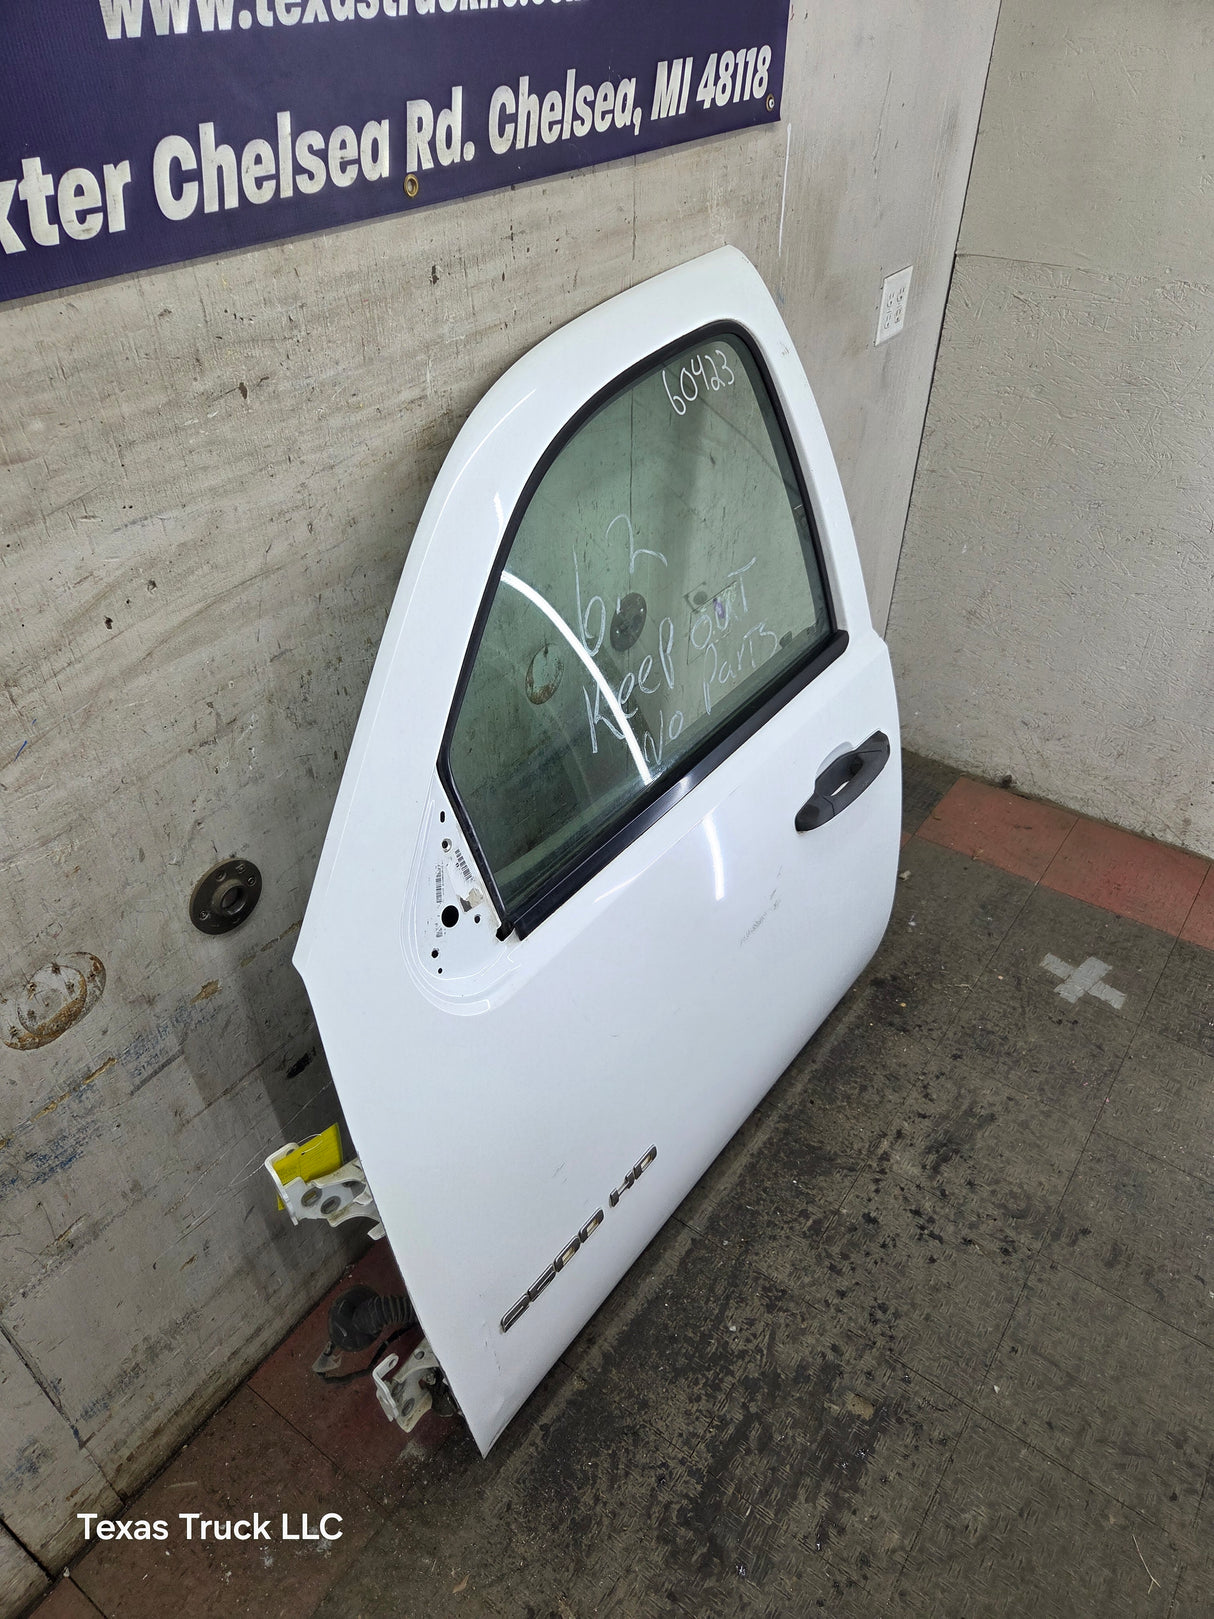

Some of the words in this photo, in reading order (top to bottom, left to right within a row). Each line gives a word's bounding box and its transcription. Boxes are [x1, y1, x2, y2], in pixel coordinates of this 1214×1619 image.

[152, 110, 390, 221] Chelsea
[406, 86, 475, 173] Rd.
[488, 68, 642, 155] Chelsea,
[650, 56, 694, 121] MI
[696, 44, 772, 110] 48118
[662, 349, 735, 415] 60423
[609, 1144, 658, 1208] HD
